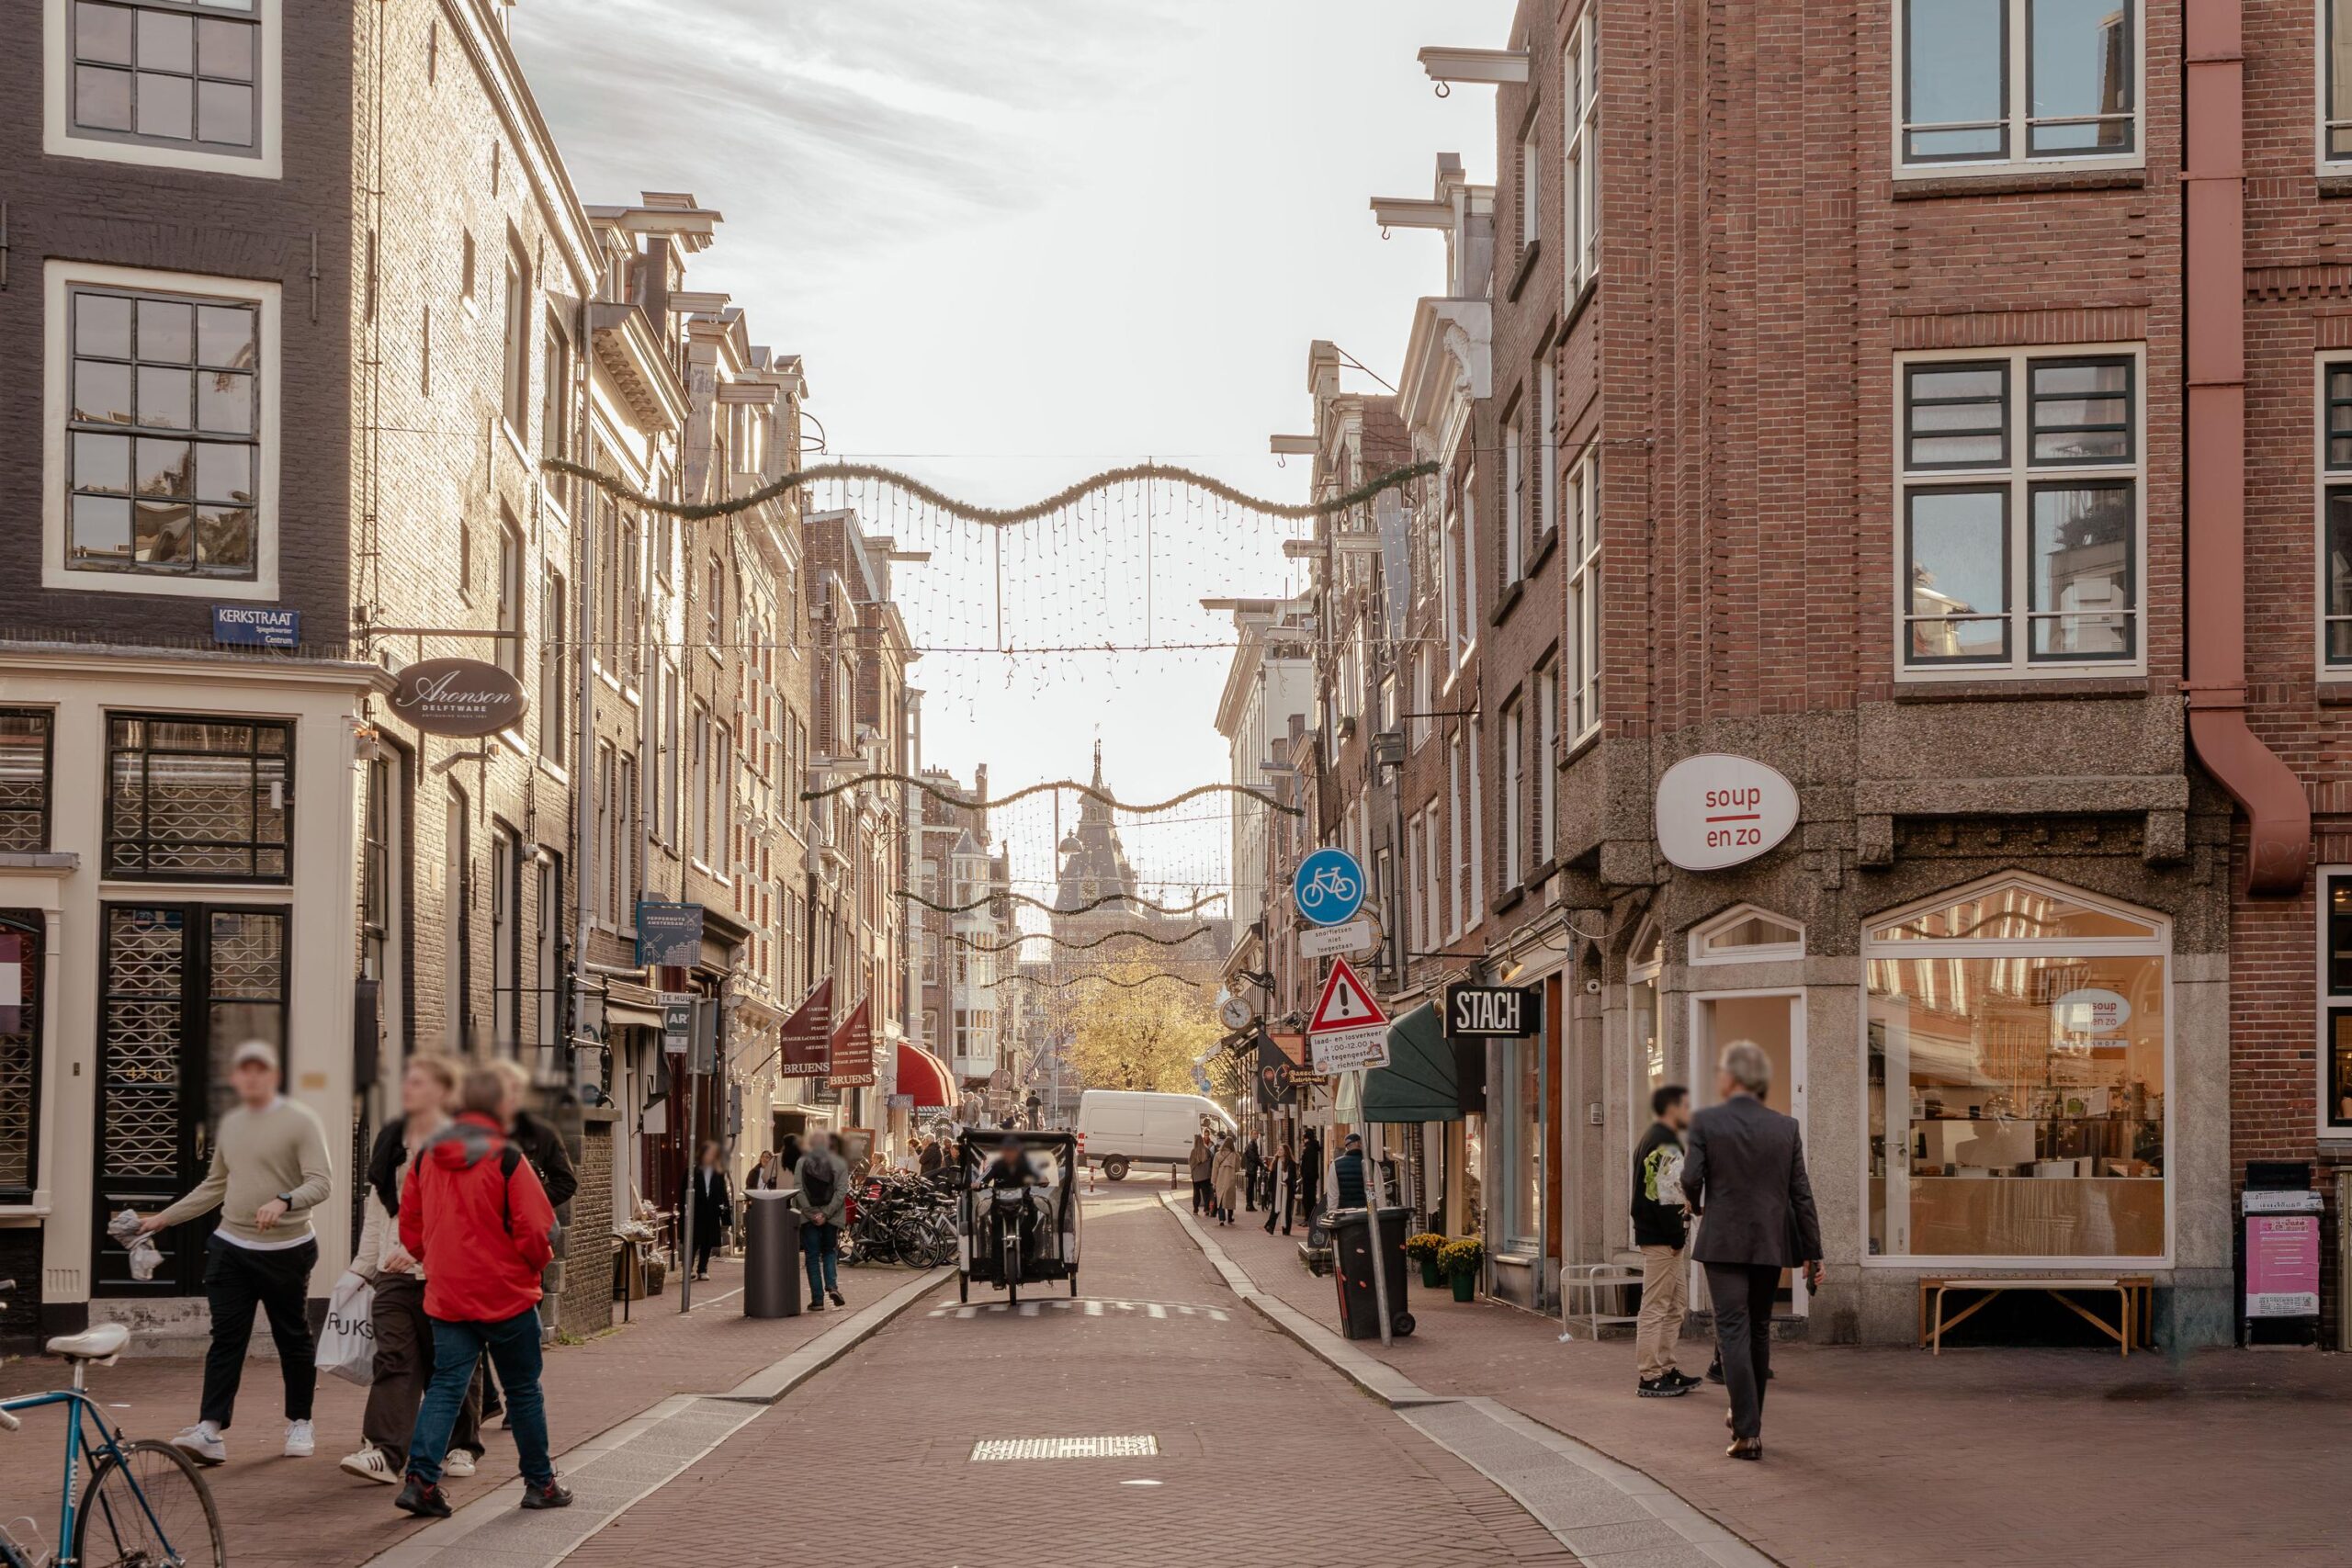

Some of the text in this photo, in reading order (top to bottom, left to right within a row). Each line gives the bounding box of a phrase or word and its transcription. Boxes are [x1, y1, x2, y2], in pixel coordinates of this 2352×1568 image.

[219, 609, 293, 626] KERKSTRAAT
[265, 635, 293, 644] Centrum
[395, 670, 513, 706] Aronson
[1705, 787, 1760, 811] soup
[1706, 828, 1761, 848] en zo
[1315, 927, 1352, 937] snorfietsen
[1317, 942, 1353, 953] toegestaan
[1456, 991, 1520, 1029] STACH
[2092, 1002, 2117, 1012] soup
[668, 1013, 689, 1024] AR
[1314, 1037, 1332, 1045] laad-
[1345, 1031, 1383, 1041] losverkeer
[1331, 1051, 1371, 1061] tegengeste
[783, 1062, 831, 1074] BRUENS
[1337, 1060, 1365, 1069] richting
[830, 1074, 872, 1085] BRUENS
